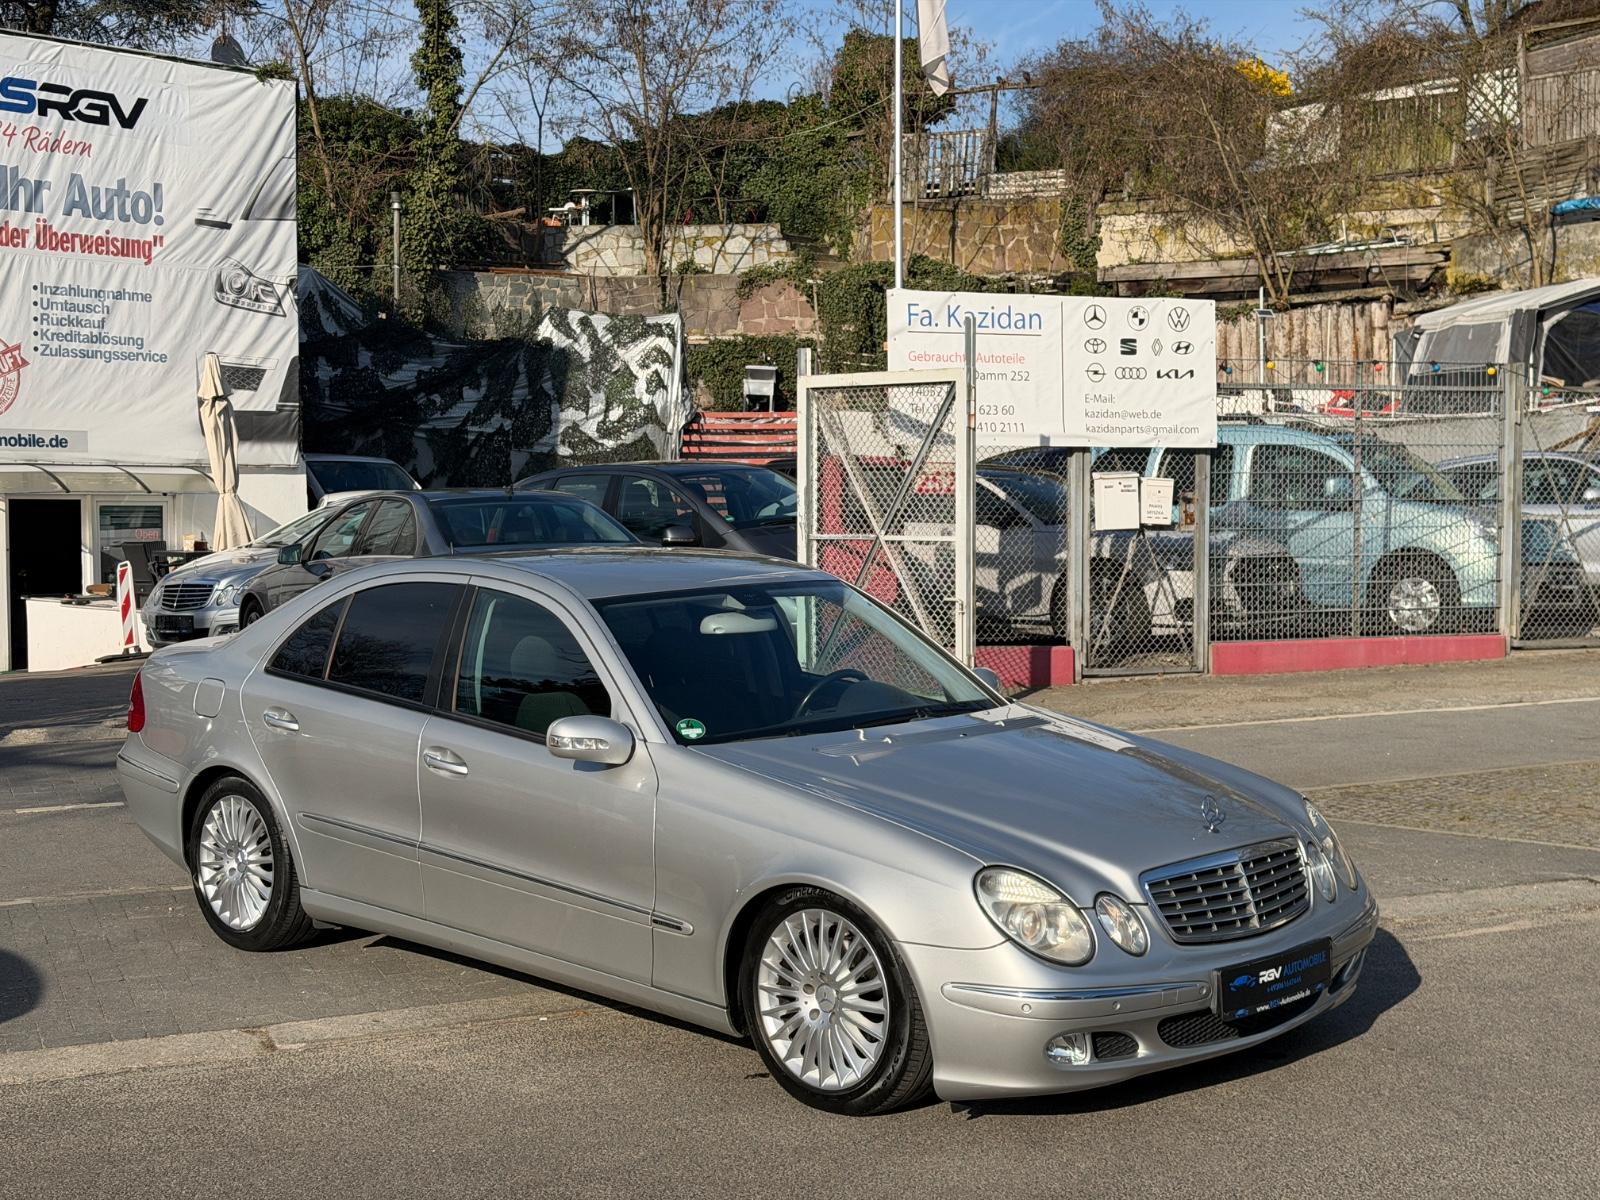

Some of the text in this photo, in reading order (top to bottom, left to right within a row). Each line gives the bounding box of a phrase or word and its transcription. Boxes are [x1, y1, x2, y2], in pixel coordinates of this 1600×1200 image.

[2, 122, 92, 158] 4 Rädern
[62, 172, 165, 226] Auto!
[35, 217, 164, 265] Überweisung"
[39, 281, 152, 303] Inzahlungnahme
[39, 297, 110, 315] Umtausch
[39, 312, 106, 330] Rückkauf
[907, 303, 939, 328] Fa.
[39, 328, 144, 349] Kreditablösung
[39, 343, 168, 363] Zulassungsservice
[976, 352, 1026, 365] Autoteile
[1010, 370, 1030, 382] 252
[1084, 394, 1116, 405] E-Mail:
[978, 404, 1015, 416] 623 60
[1084, 408, 1162, 420] kazidan@web.de
[1000, 422, 1025, 433] 2111
[1085, 423, 1200, 436] kazidanparts@gmail.com
[1258, 965, 1283, 984] RGV
[1284, 951, 1326, 977] AUTOMOBILE
